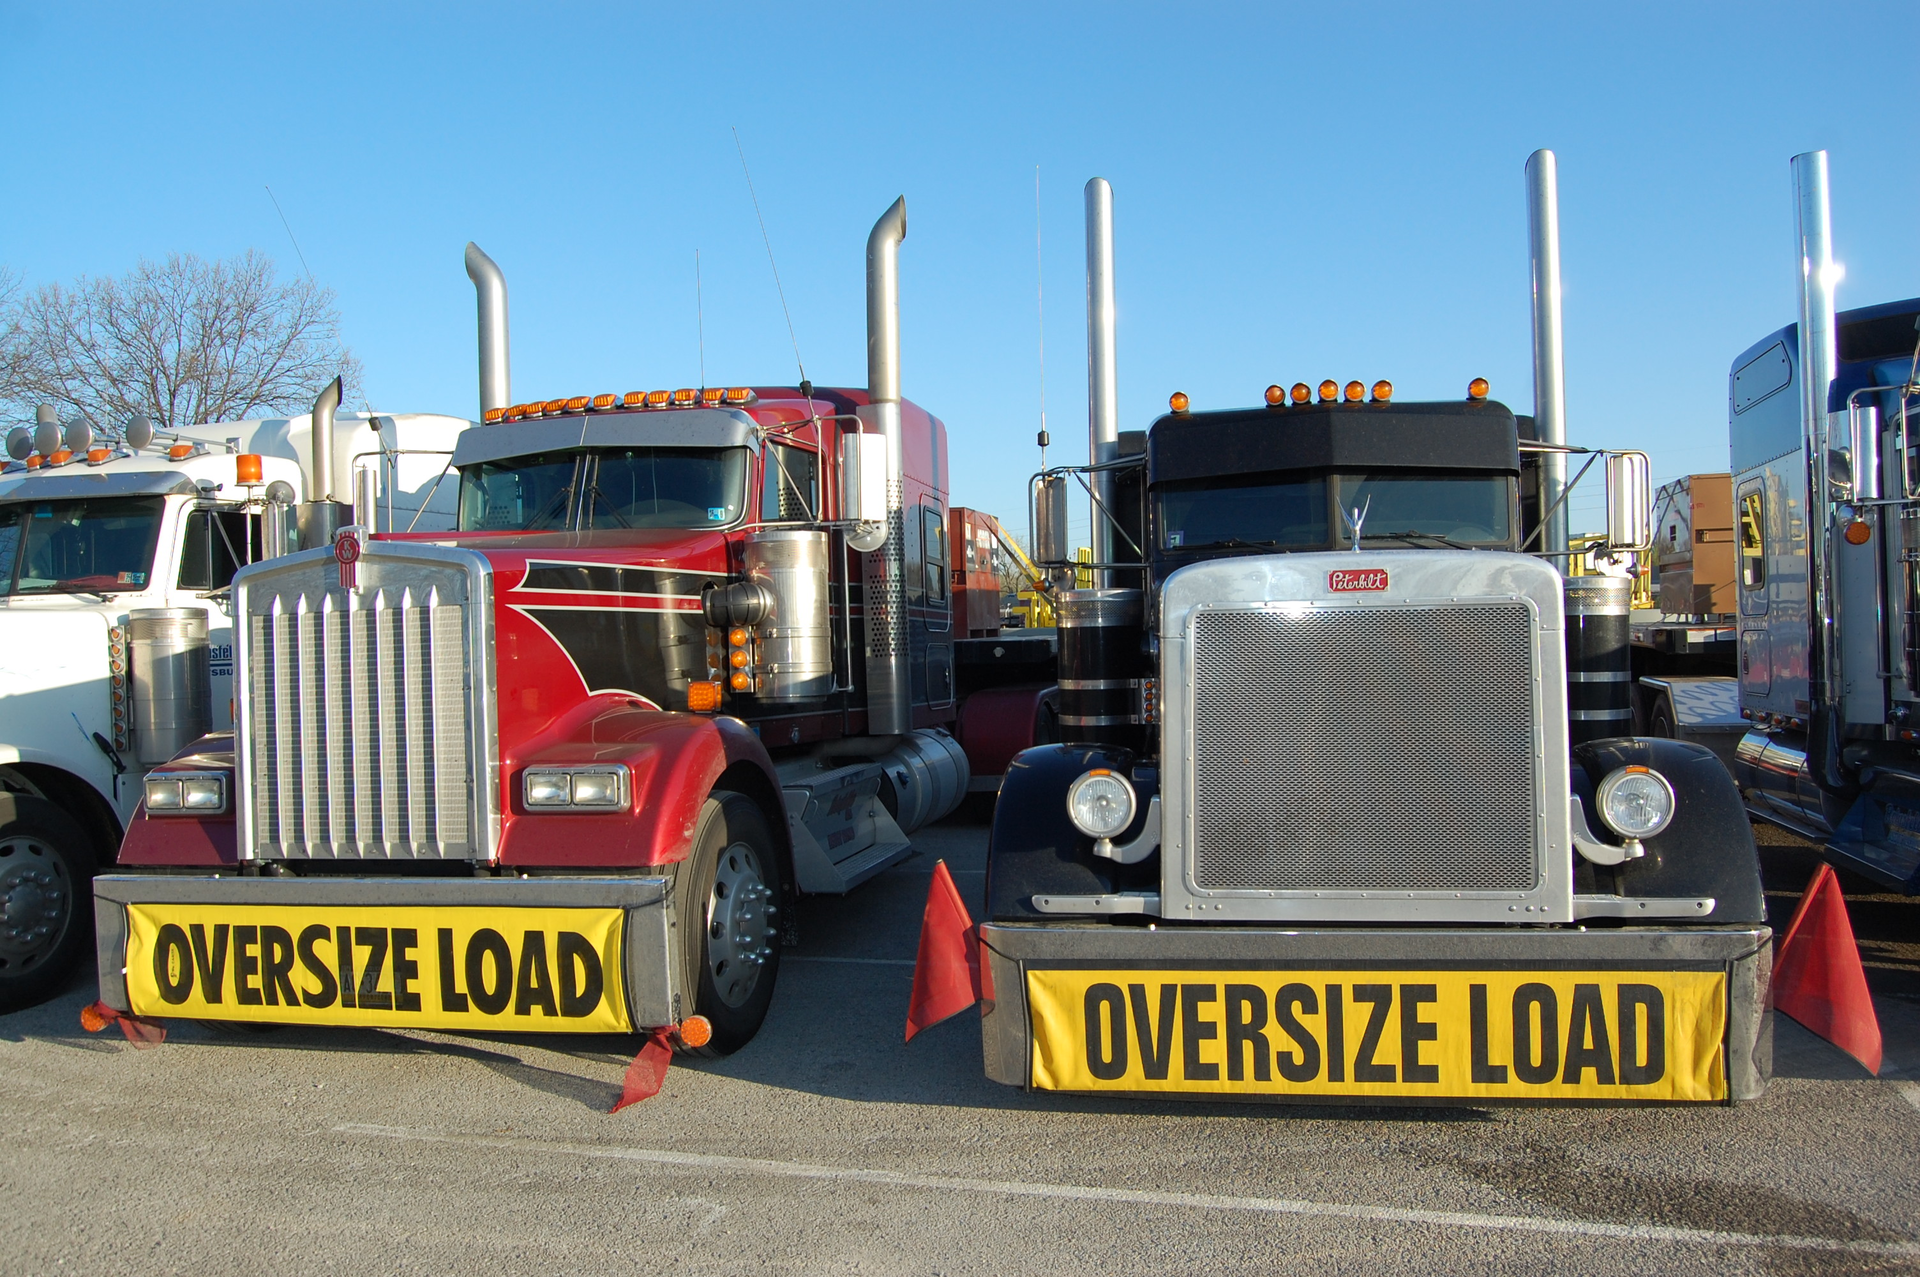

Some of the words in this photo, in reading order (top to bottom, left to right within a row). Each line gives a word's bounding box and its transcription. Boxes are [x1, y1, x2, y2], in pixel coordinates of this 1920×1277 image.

[1332, 571, 1387, 590] Peterbilt
[153, 924, 421, 1011] OVERSIZE
[438, 928, 603, 1017] LOAD
[1085, 983, 1438, 1083] OVERSIZE
[1470, 983, 1665, 1085] LOAD
